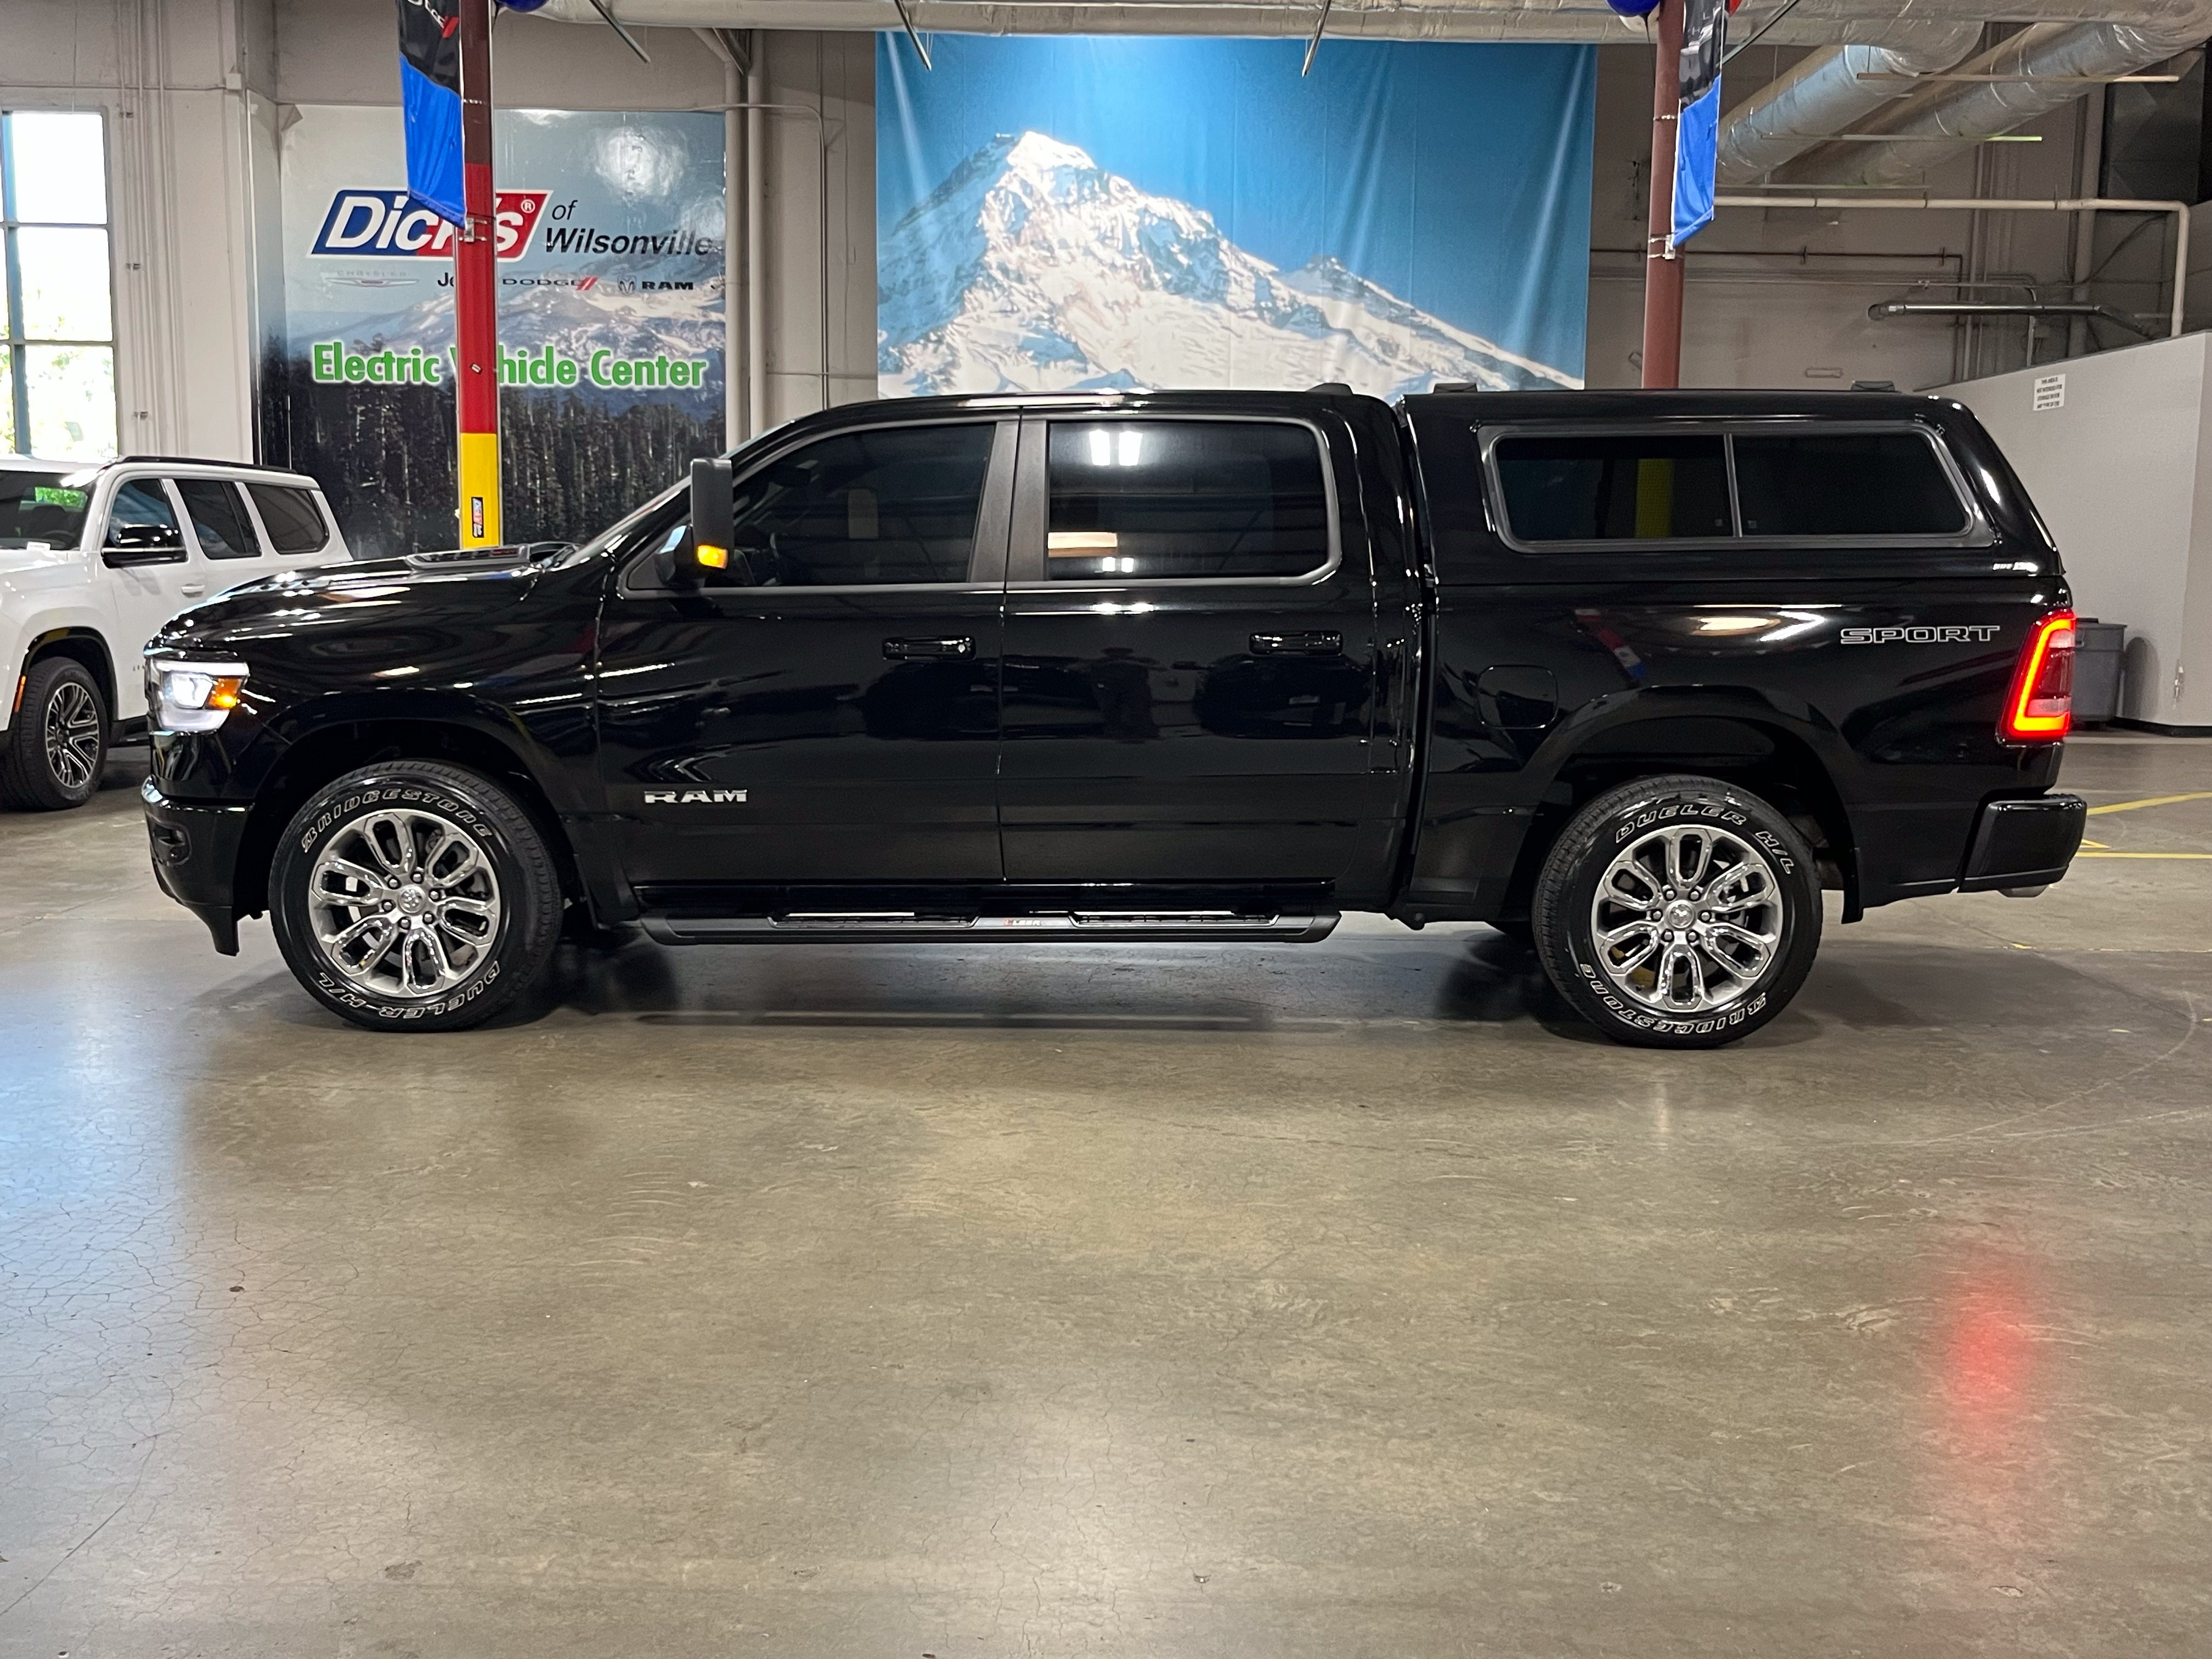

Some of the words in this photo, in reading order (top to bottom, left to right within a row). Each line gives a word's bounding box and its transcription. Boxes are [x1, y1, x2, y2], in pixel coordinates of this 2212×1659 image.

[551, 200, 578, 221] of
[546, 227, 713, 255] Wilsonville
[641, 280, 694, 290] RAM
[314, 341, 440, 383] Electric
[450, 345, 577, 384] hicle
[591, 349, 707, 386] Center
[1840, 625, 2001, 645] SPORT
[644, 789, 746, 804] RAM
[302, 788, 493, 854] BRIDGESTONE
[1615, 804, 1748, 844] DUELER
[378, 960, 501, 1019] DUELER
[1579, 962, 1767, 1035] BRIDGESTONE
